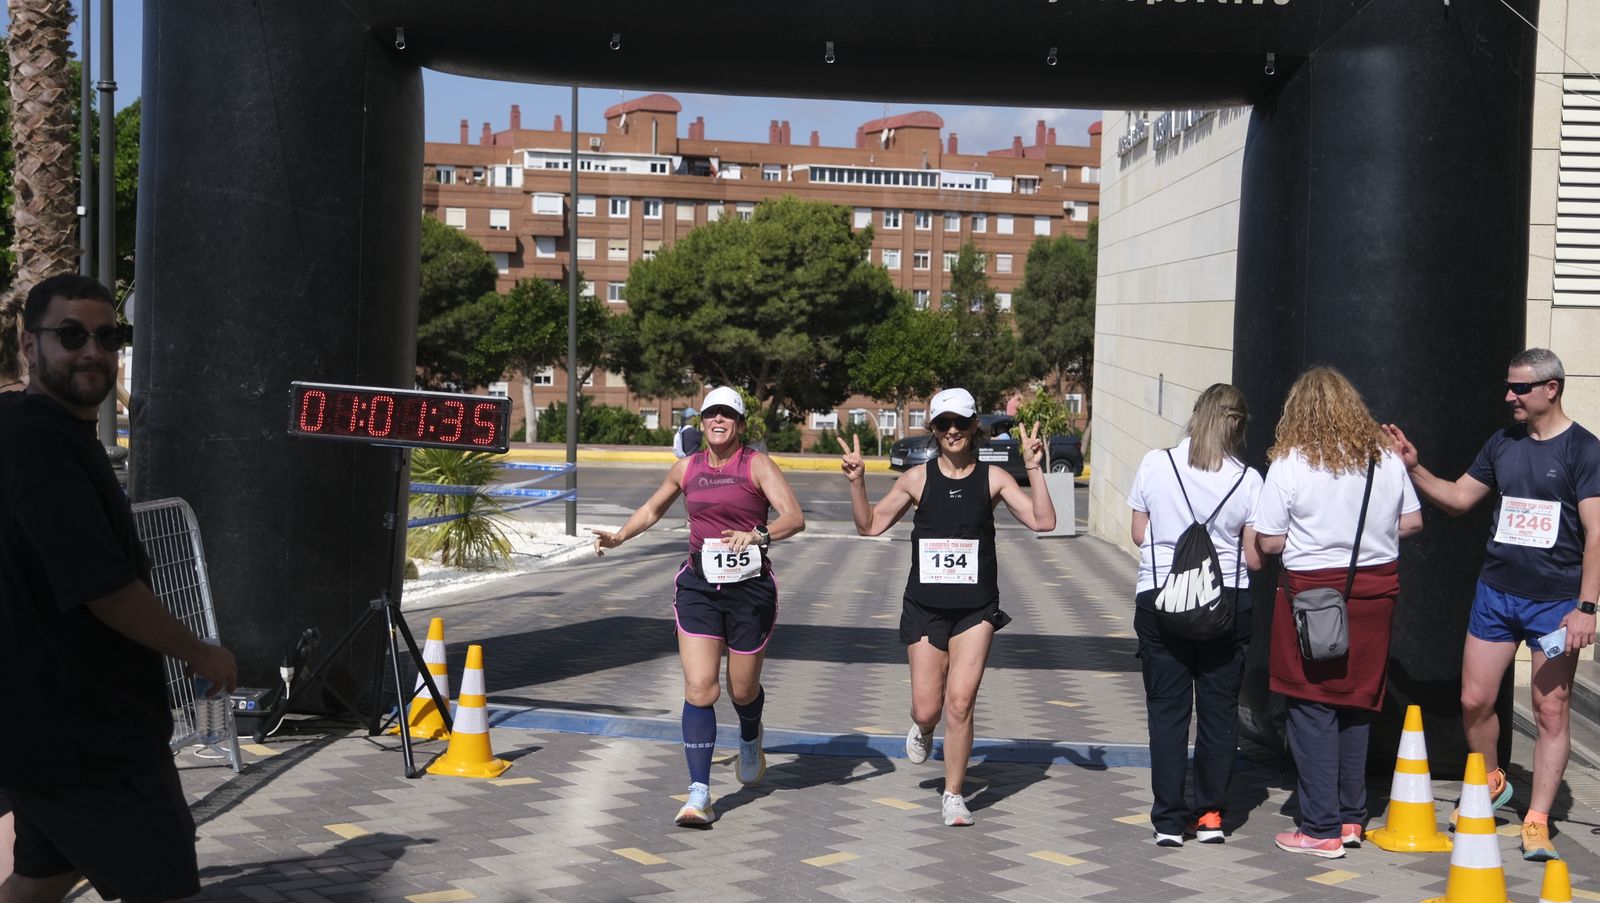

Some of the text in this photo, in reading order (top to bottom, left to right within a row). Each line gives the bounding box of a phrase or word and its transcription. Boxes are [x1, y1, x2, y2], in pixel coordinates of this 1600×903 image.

[300, 390, 496, 444] 01:01:35
[1507, 512, 1552, 532] 1246
[714, 552, 750, 568] 155
[932, 553, 967, 568] 154
[1155, 555, 1220, 613] NIKE
